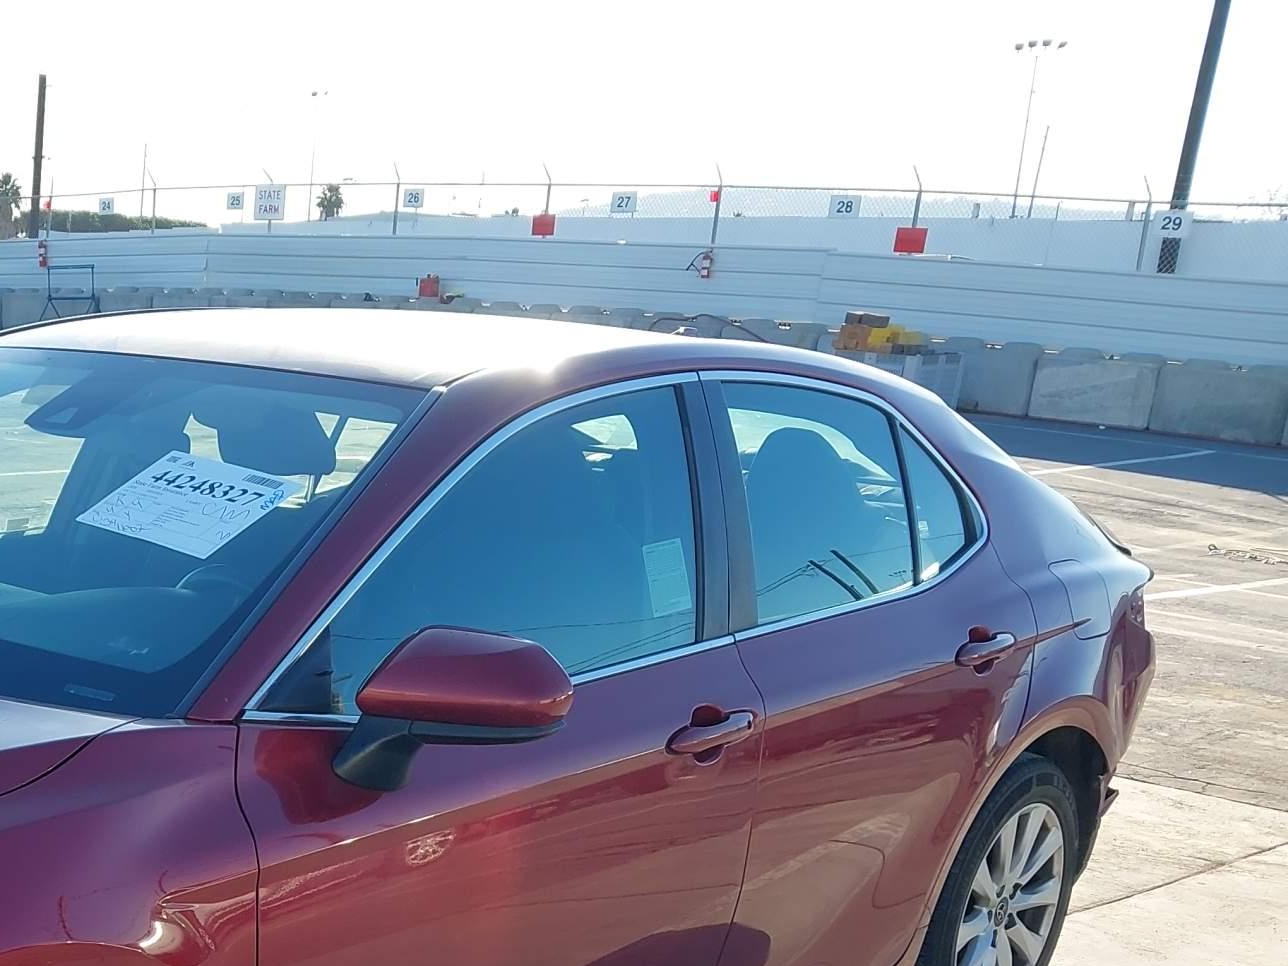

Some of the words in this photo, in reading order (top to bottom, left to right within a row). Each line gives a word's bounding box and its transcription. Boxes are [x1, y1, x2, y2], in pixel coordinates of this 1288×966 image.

[230, 195, 241, 206] 25
[258, 190, 281, 201] STATE
[407, 192, 420, 204] 26
[101, 201, 111, 212] 24
[616, 196, 631, 208] 27
[836, 200, 853, 214] 28
[258, 203, 280, 215] FARM
[1160, 215, 1183, 231] 29
[152, 470, 264, 506] 44248327
